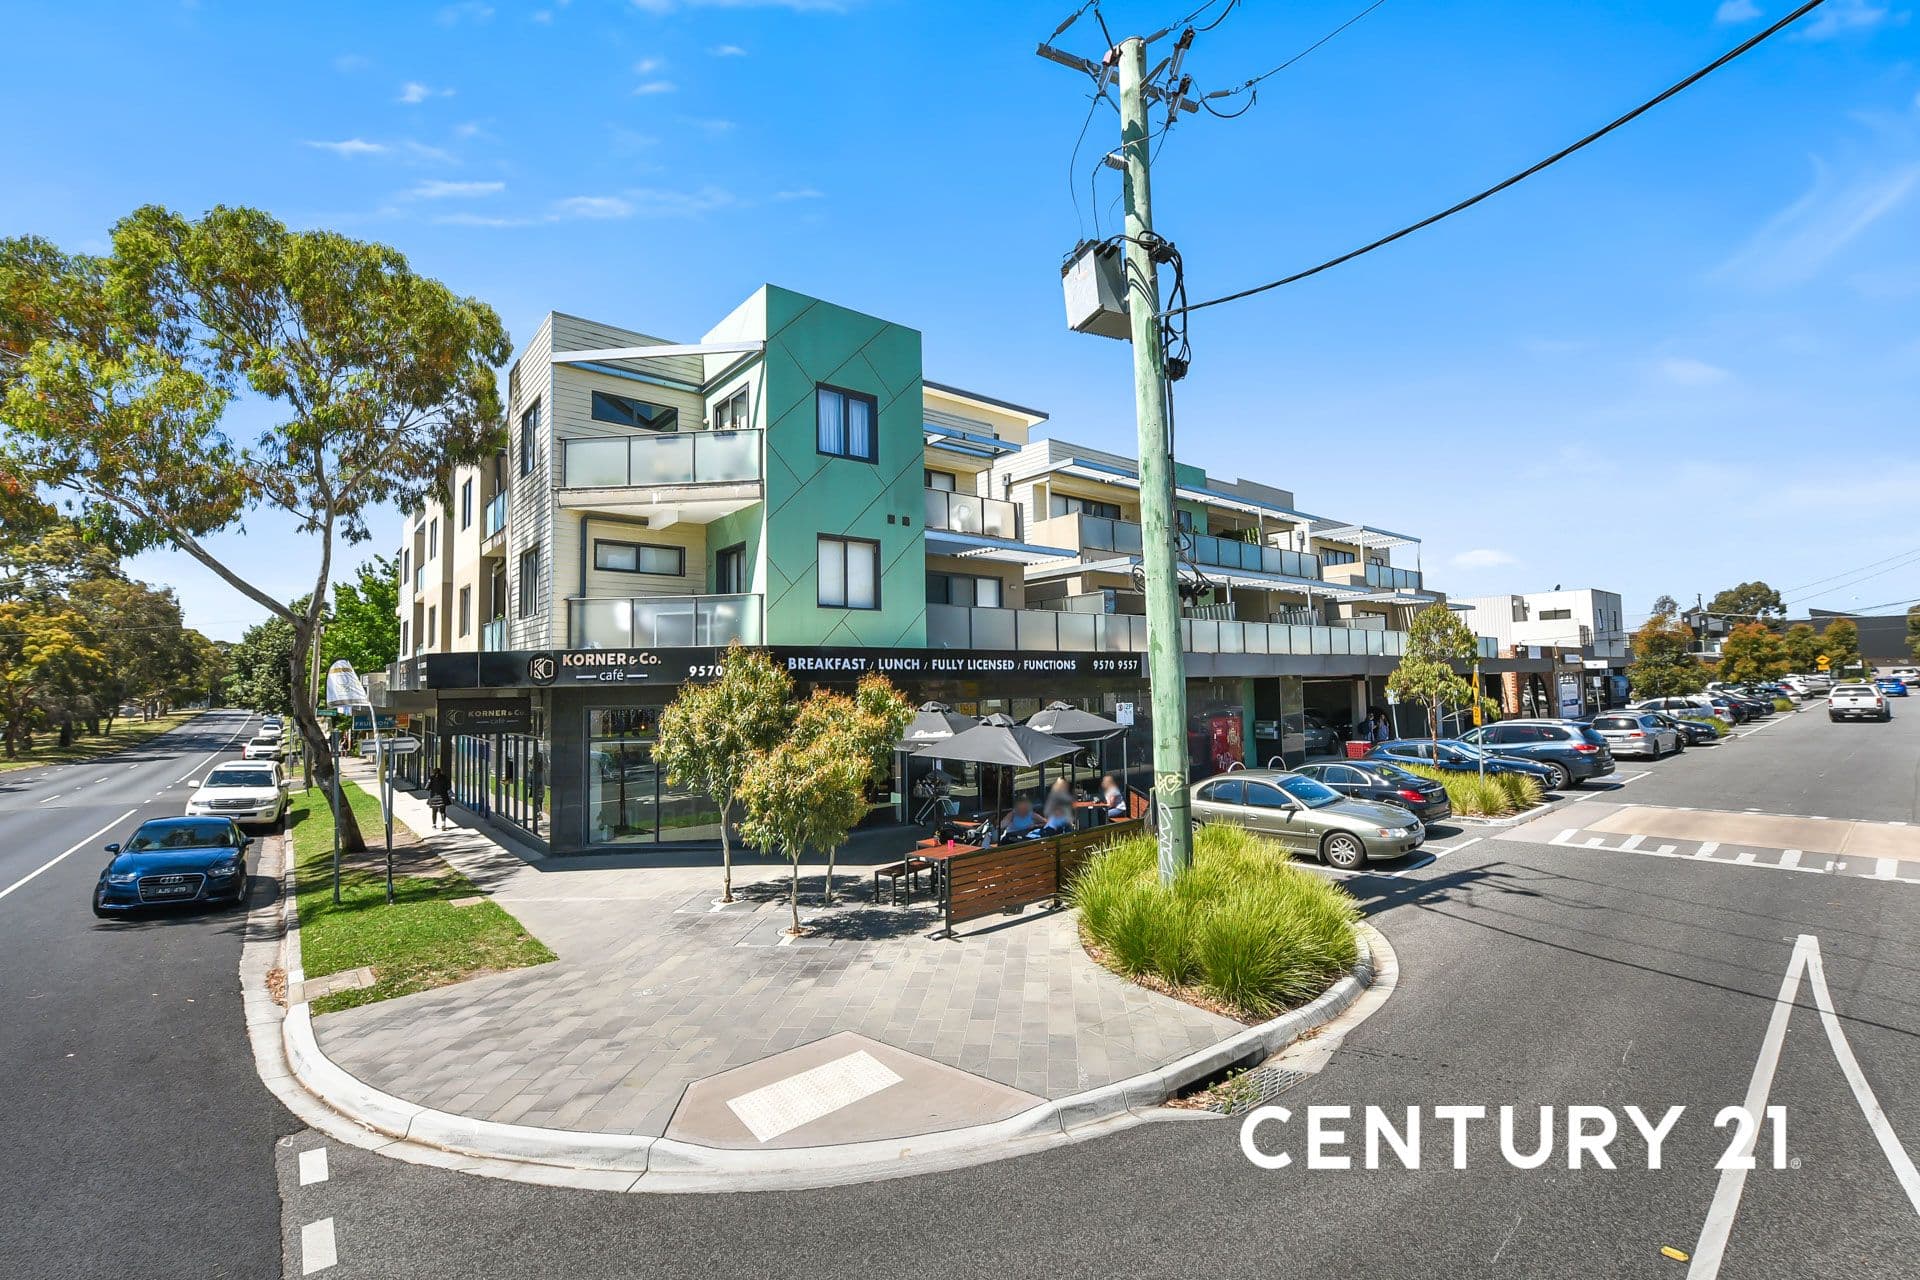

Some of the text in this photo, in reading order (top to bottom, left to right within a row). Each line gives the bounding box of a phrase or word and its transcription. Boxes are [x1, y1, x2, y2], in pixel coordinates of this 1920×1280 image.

[562, 653, 626, 666] KORNER
[639, 652, 662, 665] Co.
[788, 657, 866, 670] BREAKFAST
[878, 658, 920, 670] LUNCH
[932, 659, 965, 670] FULLY
[967, 659, 1015, 670] LICENSED
[1023, 659, 1076, 670] FUNCTIONS
[1093, 660, 1138, 670] 9570 9557
[599, 668, 624, 681] café
[689, 665, 724, 677] 9570
[467, 709, 508, 717] KORNER
